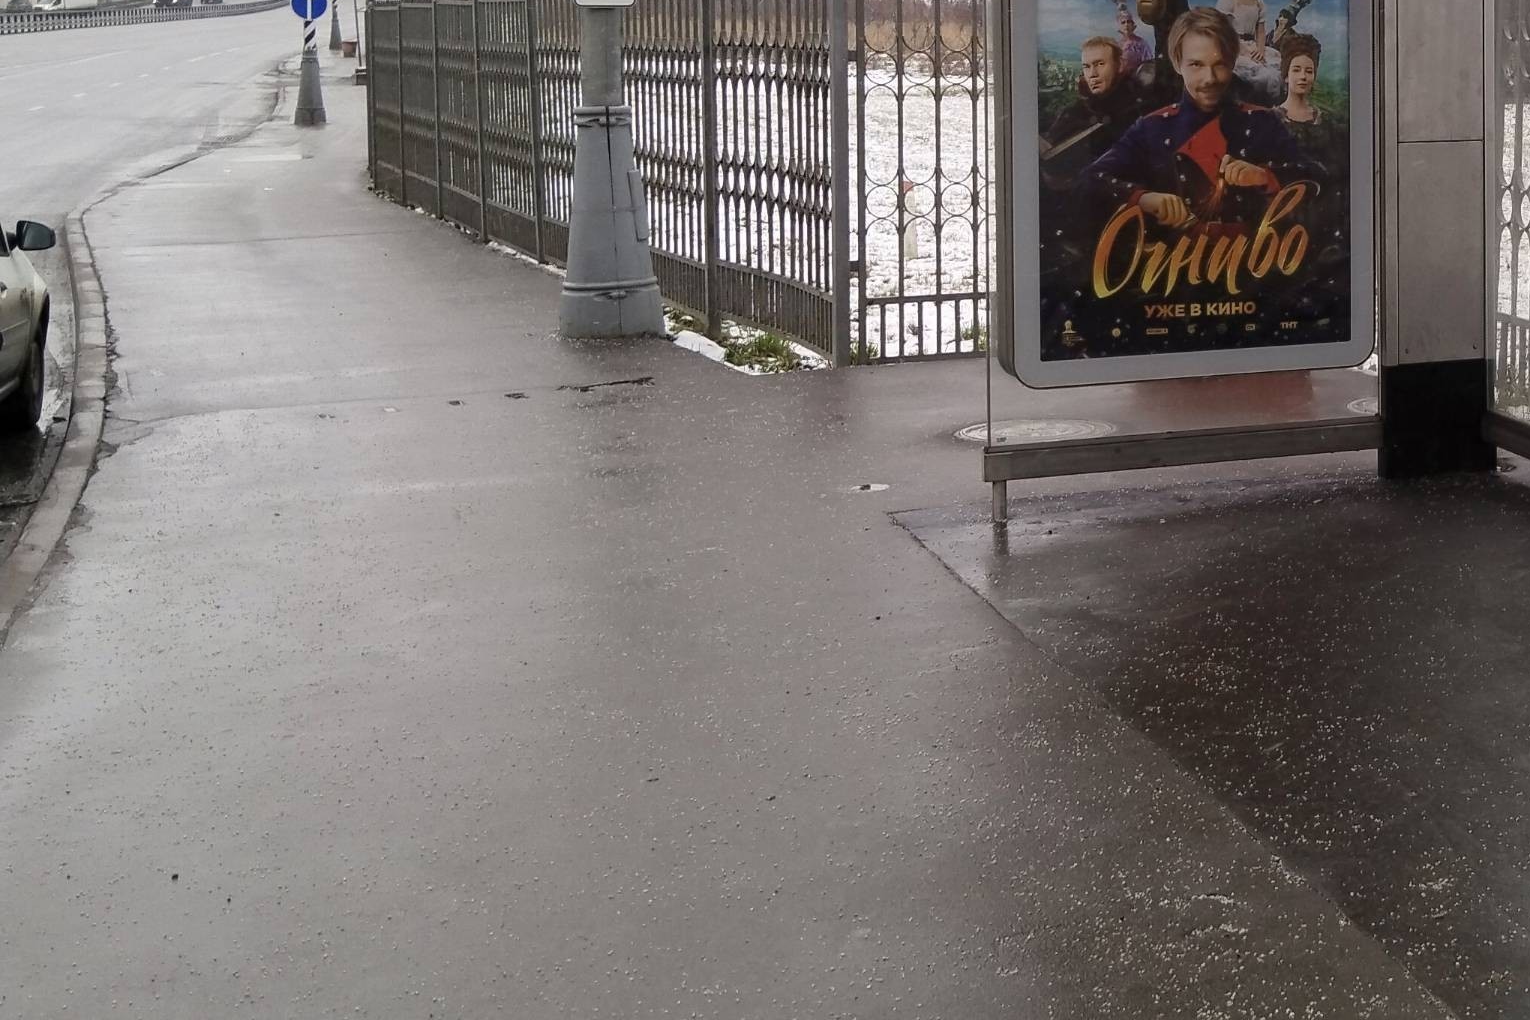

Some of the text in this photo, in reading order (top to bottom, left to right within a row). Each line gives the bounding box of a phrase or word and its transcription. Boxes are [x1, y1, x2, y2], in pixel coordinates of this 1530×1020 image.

[1143, 301, 1256, 318] УЖЕ В КИНО
